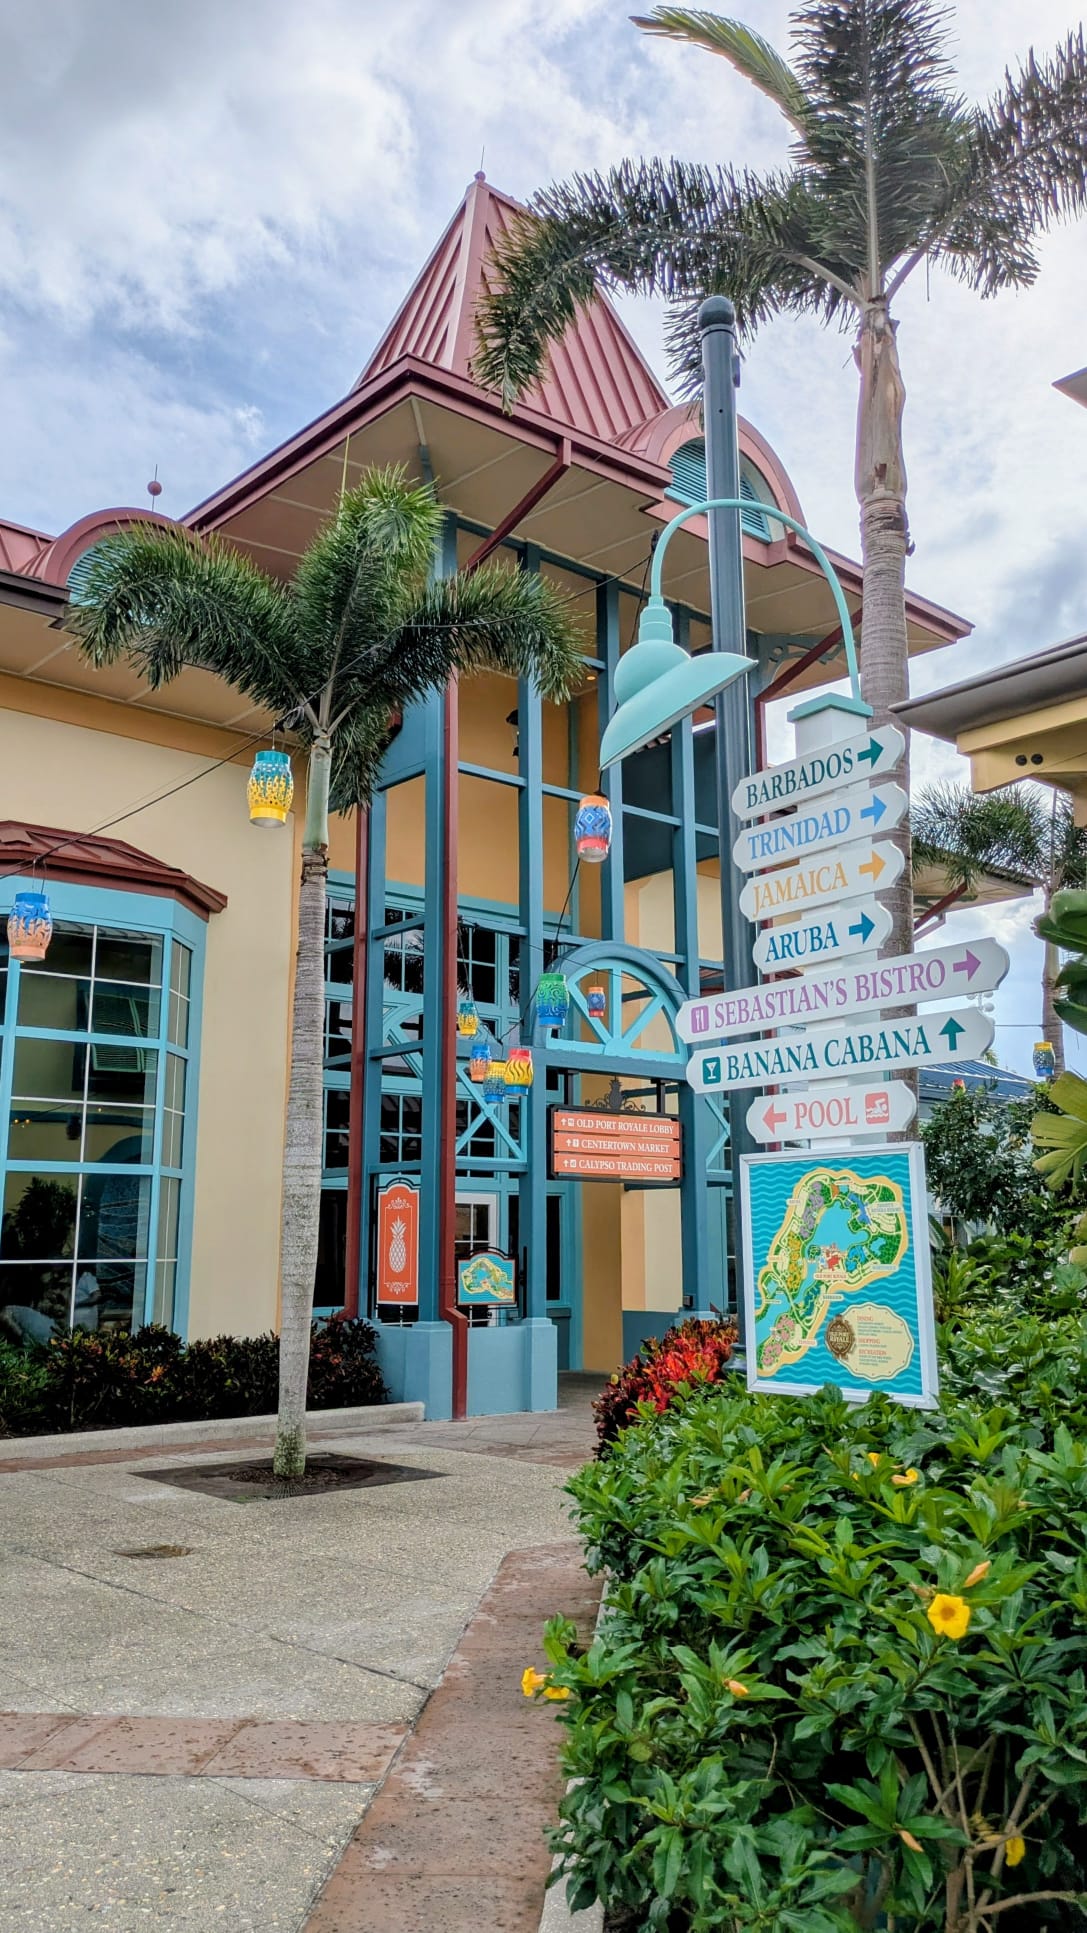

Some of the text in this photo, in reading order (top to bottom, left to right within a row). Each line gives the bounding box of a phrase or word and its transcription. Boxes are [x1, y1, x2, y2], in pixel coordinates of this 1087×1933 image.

[746, 747, 853, 809] BARBADOS
[748, 807, 851, 860] TRINIDAD
[753, 862, 848, 917] JAMAICA
[765, 921, 839, 962] ARUBA
[715, 959, 946, 1028] SEBASTIAN'S BISTRO
[727, 1025, 932, 1080] BANANA CABANA
[577, 1118, 674, 1134] OLD PORT ROYALE LOBBY
[794, 1096, 858, 1130] POOL
[579, 1159, 673, 1173] CALYPSO TRADING POST
[581, 1139, 670, 1153] CENTERTOWN MARKET
